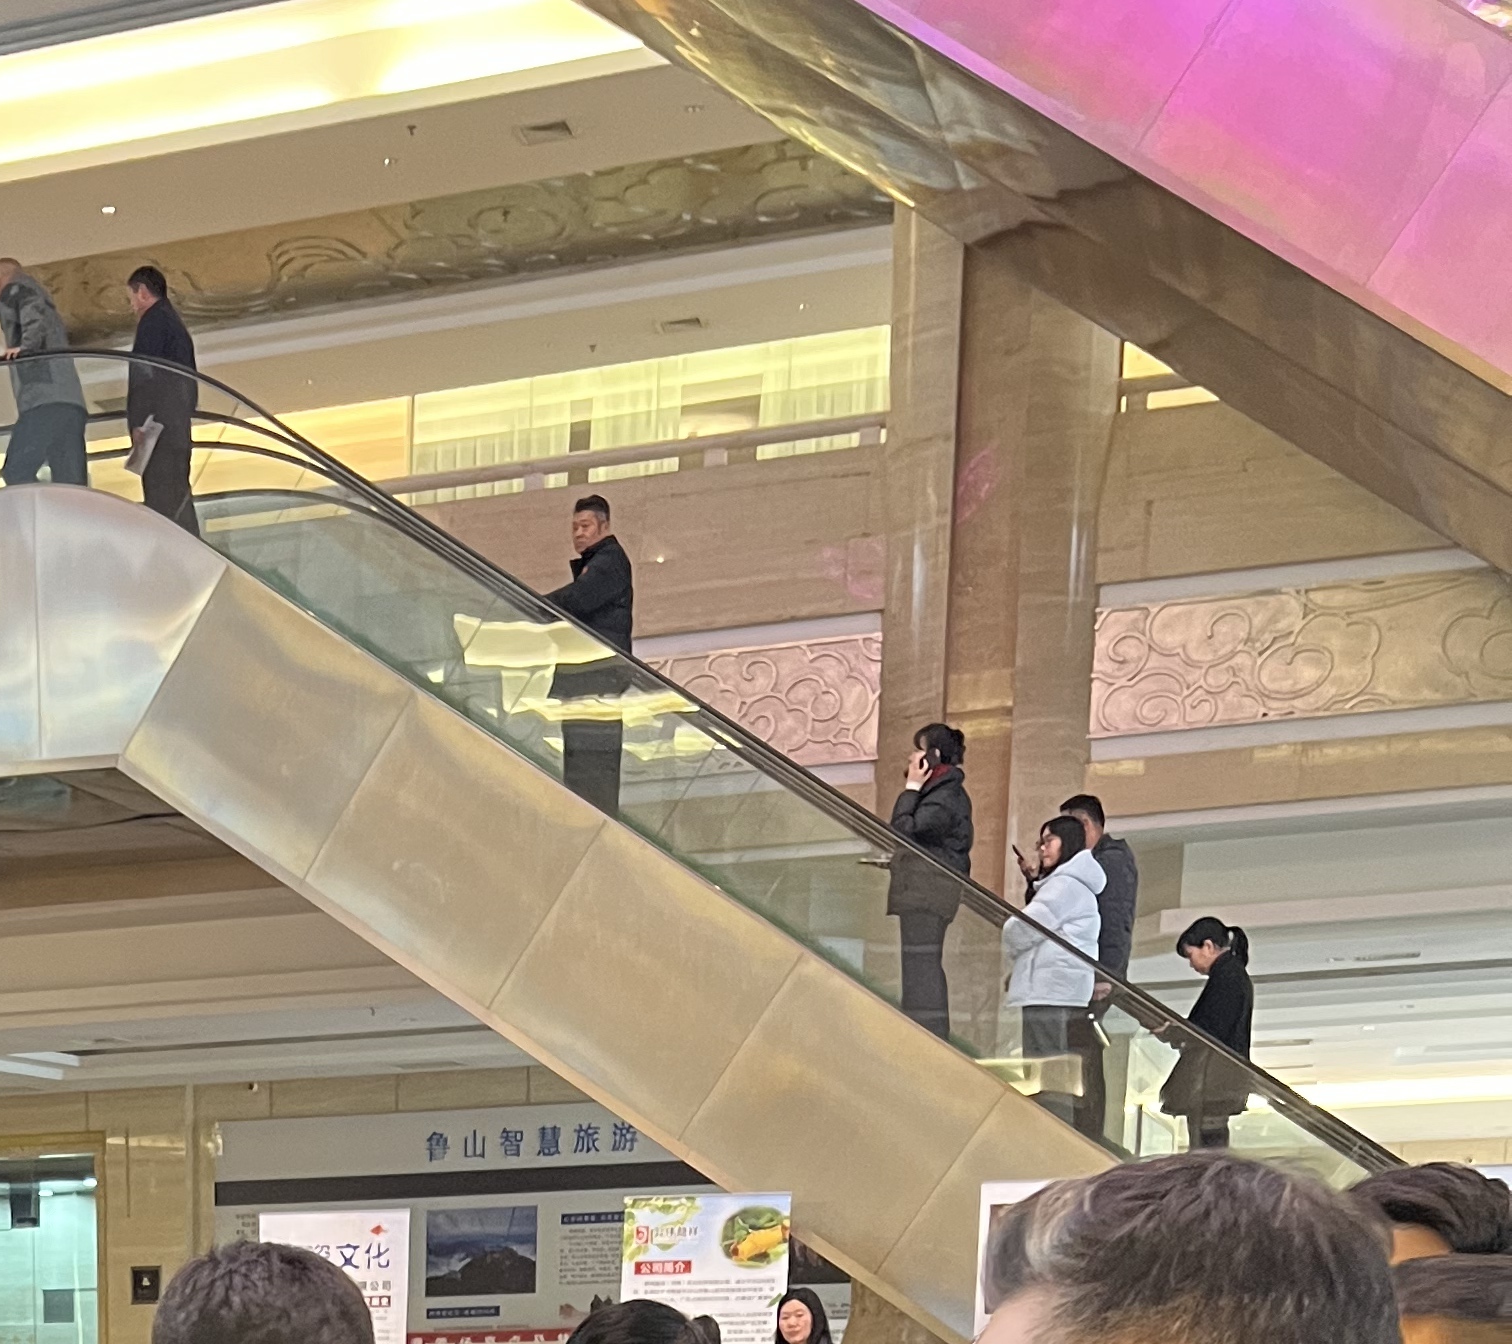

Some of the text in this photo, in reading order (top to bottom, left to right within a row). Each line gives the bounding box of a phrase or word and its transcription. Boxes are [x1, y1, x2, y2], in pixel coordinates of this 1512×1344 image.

[426, 1121, 638, 1162] 鲁山智慧旅游
